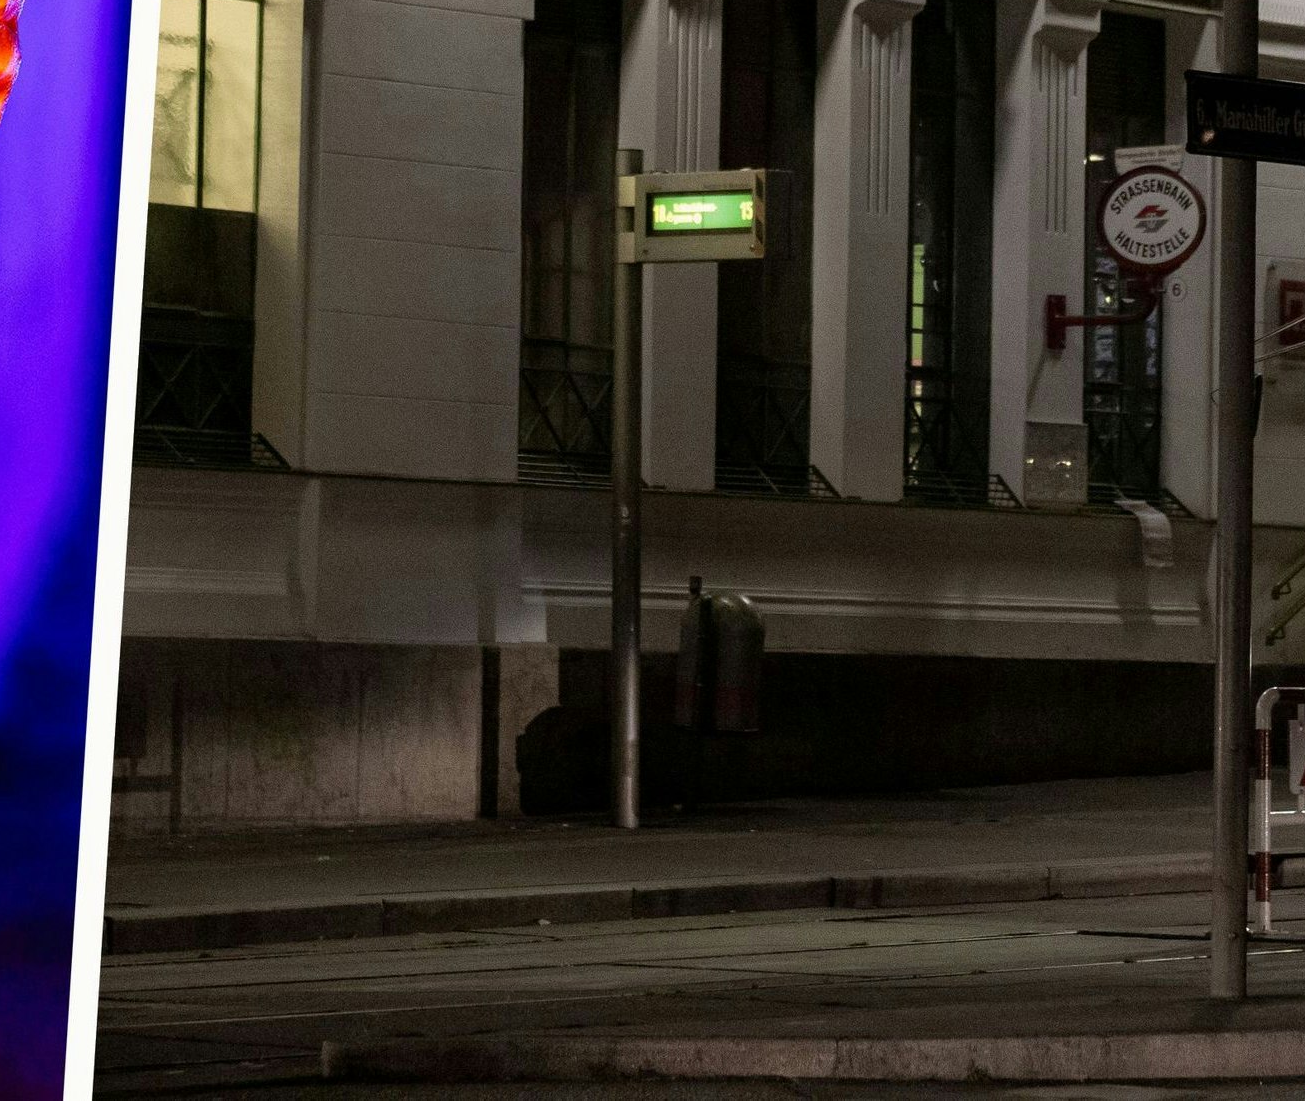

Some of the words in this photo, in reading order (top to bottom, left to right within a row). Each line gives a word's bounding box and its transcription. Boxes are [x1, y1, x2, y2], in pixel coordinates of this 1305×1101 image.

[1110, 179, 1193, 215] STRASSENBAHN
[1114, 228, 1190, 259] HALTESTELLE
[1172, 283, 1182, 297] 6
